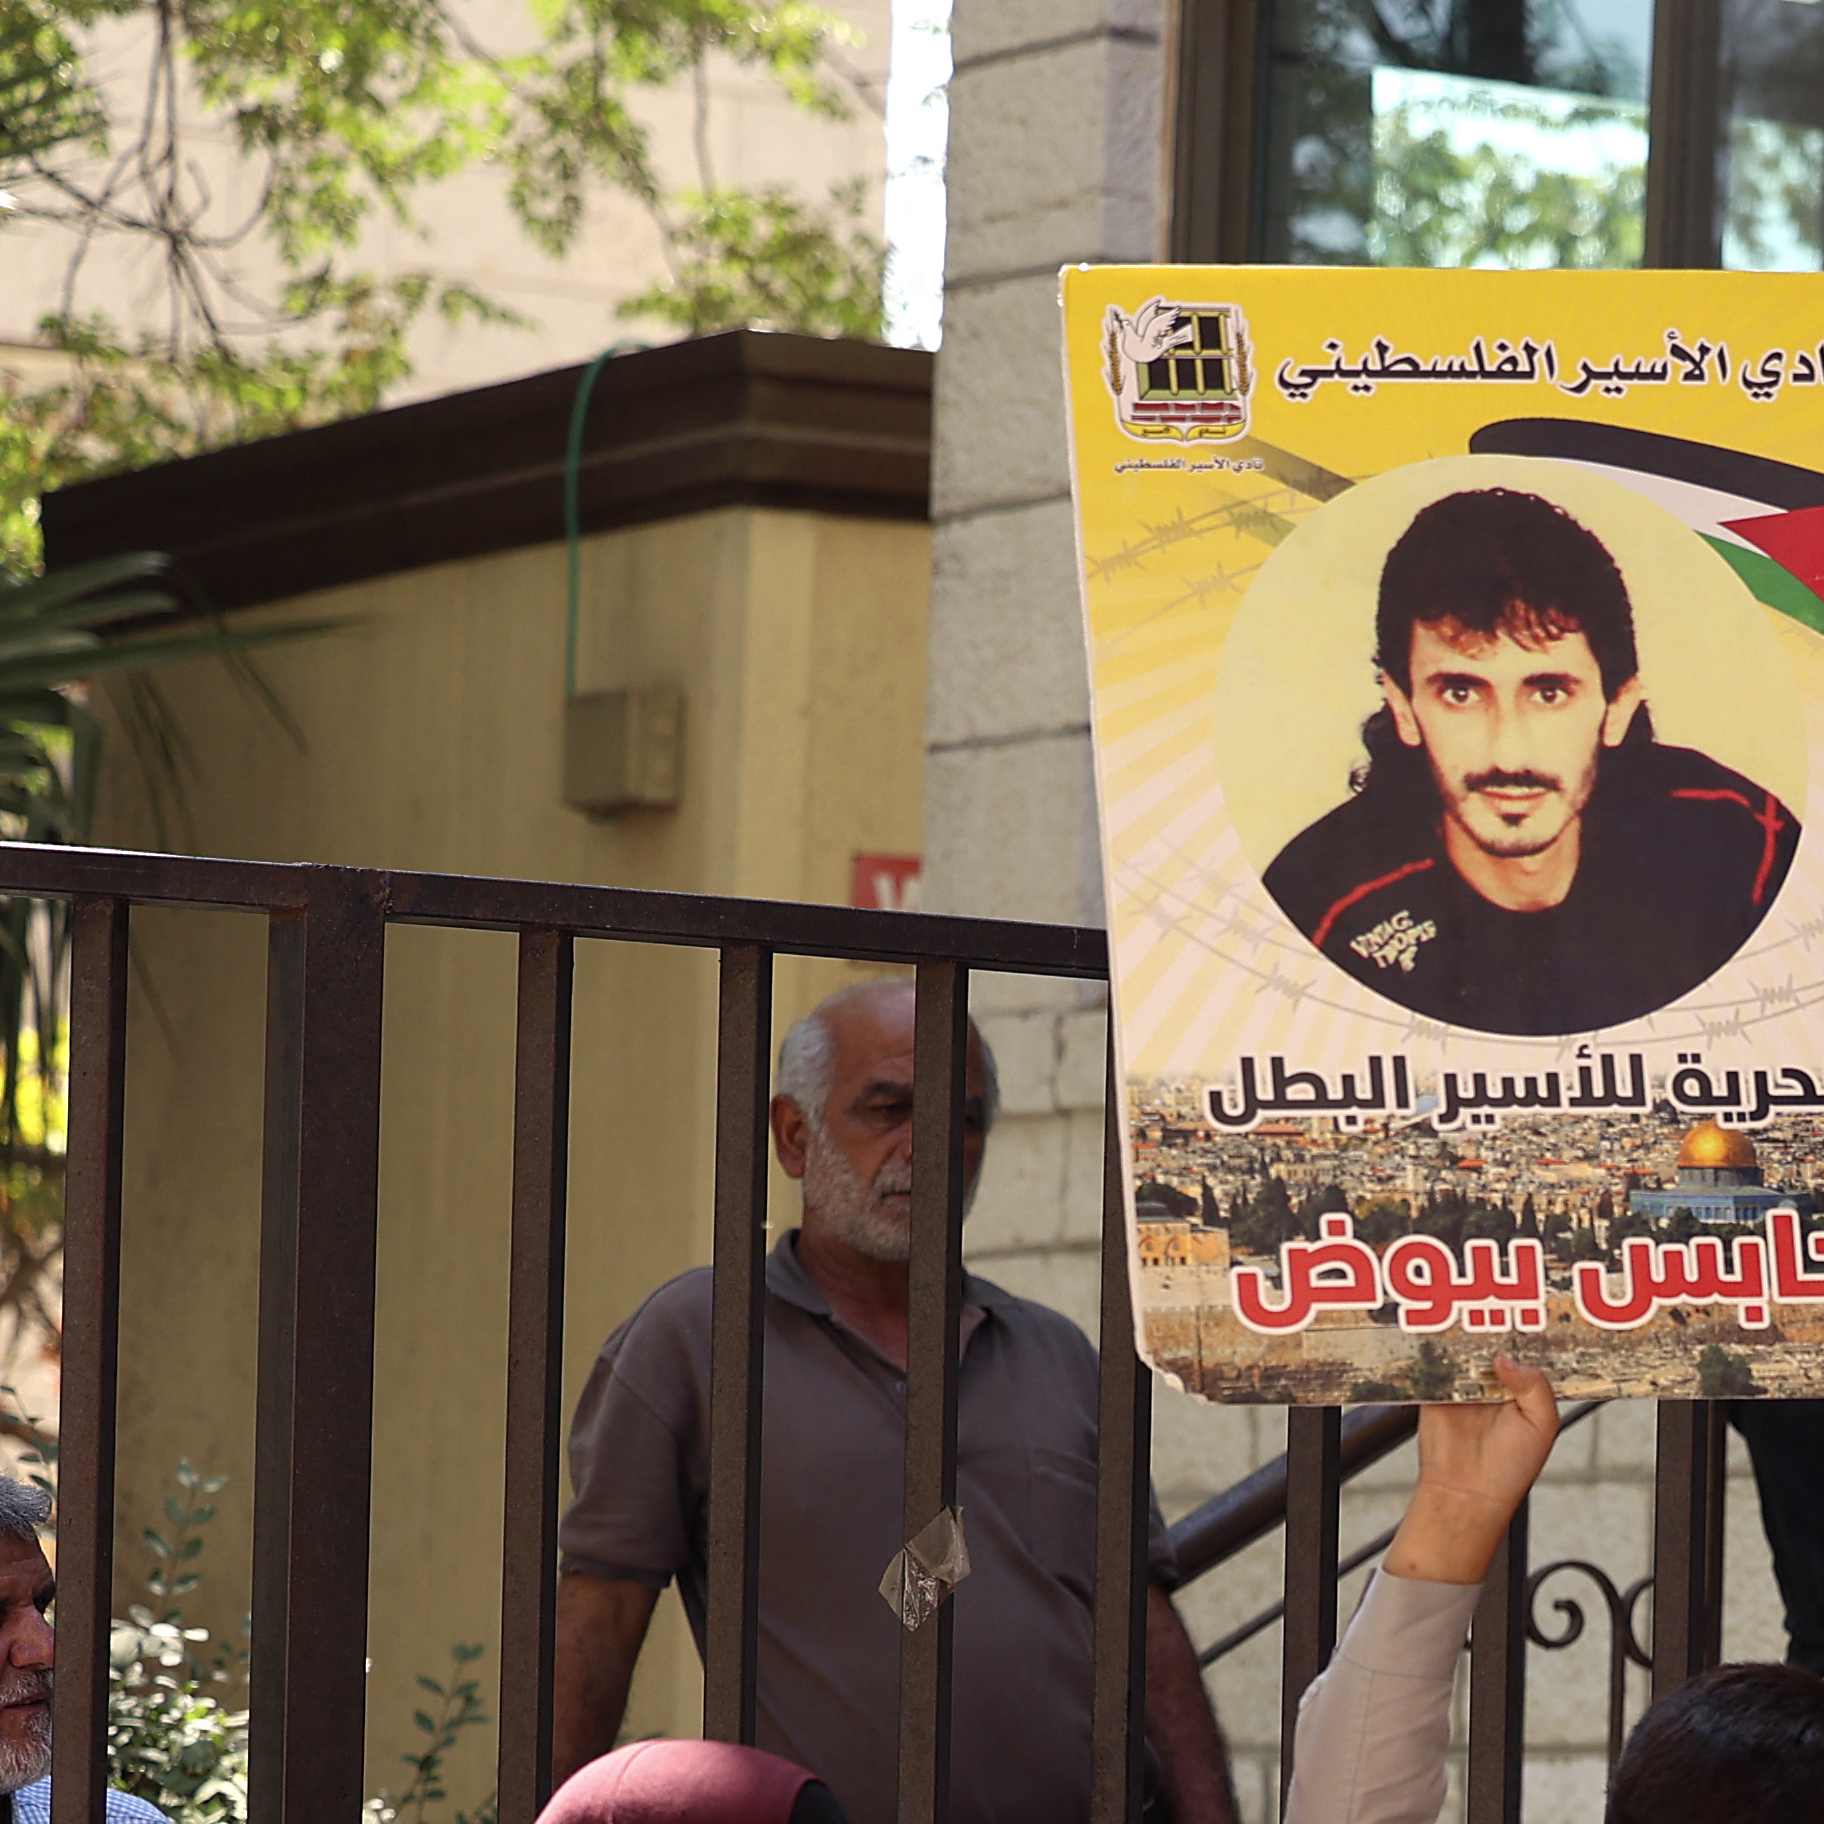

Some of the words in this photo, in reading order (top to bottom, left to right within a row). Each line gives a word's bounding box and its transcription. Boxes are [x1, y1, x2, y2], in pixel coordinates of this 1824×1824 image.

[1276, 338, 1556, 401] الفلسطيني
[1561, 328, 1729, 395] الأسير
[1211, 1056, 1408, 1127] البطل
[1442, 1044, 1646, 1125] للأسير
[1239, 1217, 1539, 1328] بيوض
